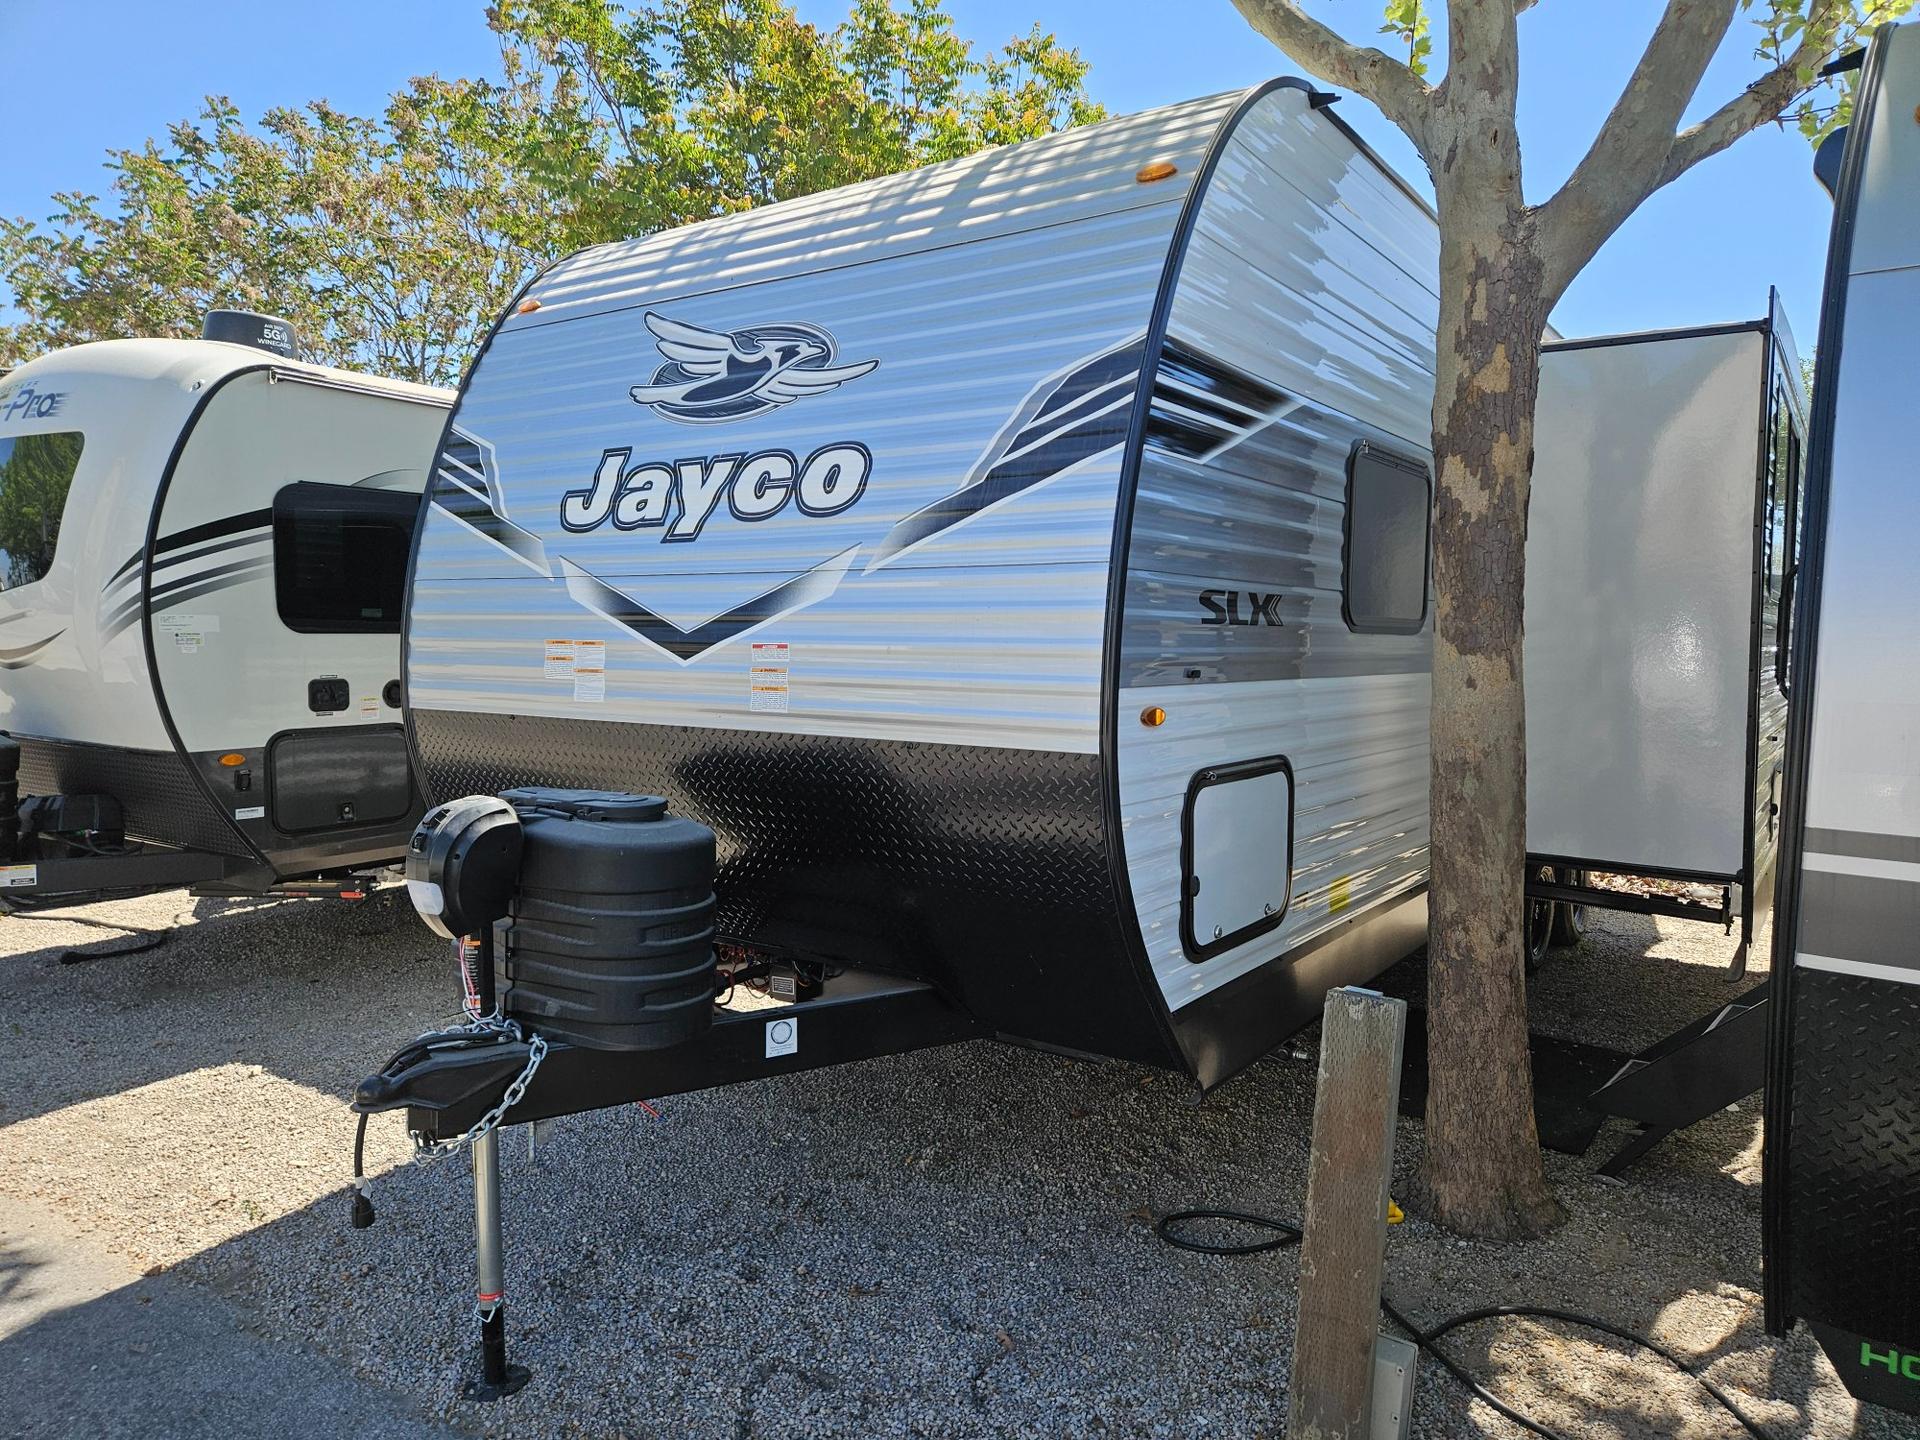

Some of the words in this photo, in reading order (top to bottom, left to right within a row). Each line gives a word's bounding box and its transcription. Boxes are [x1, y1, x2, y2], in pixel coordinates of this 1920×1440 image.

[264, 329, 281, 340] 5G
[0, 389, 56, 421] -Pro
[560, 441, 873, 544] Jayco
[1199, 590, 1283, 626] SLX
